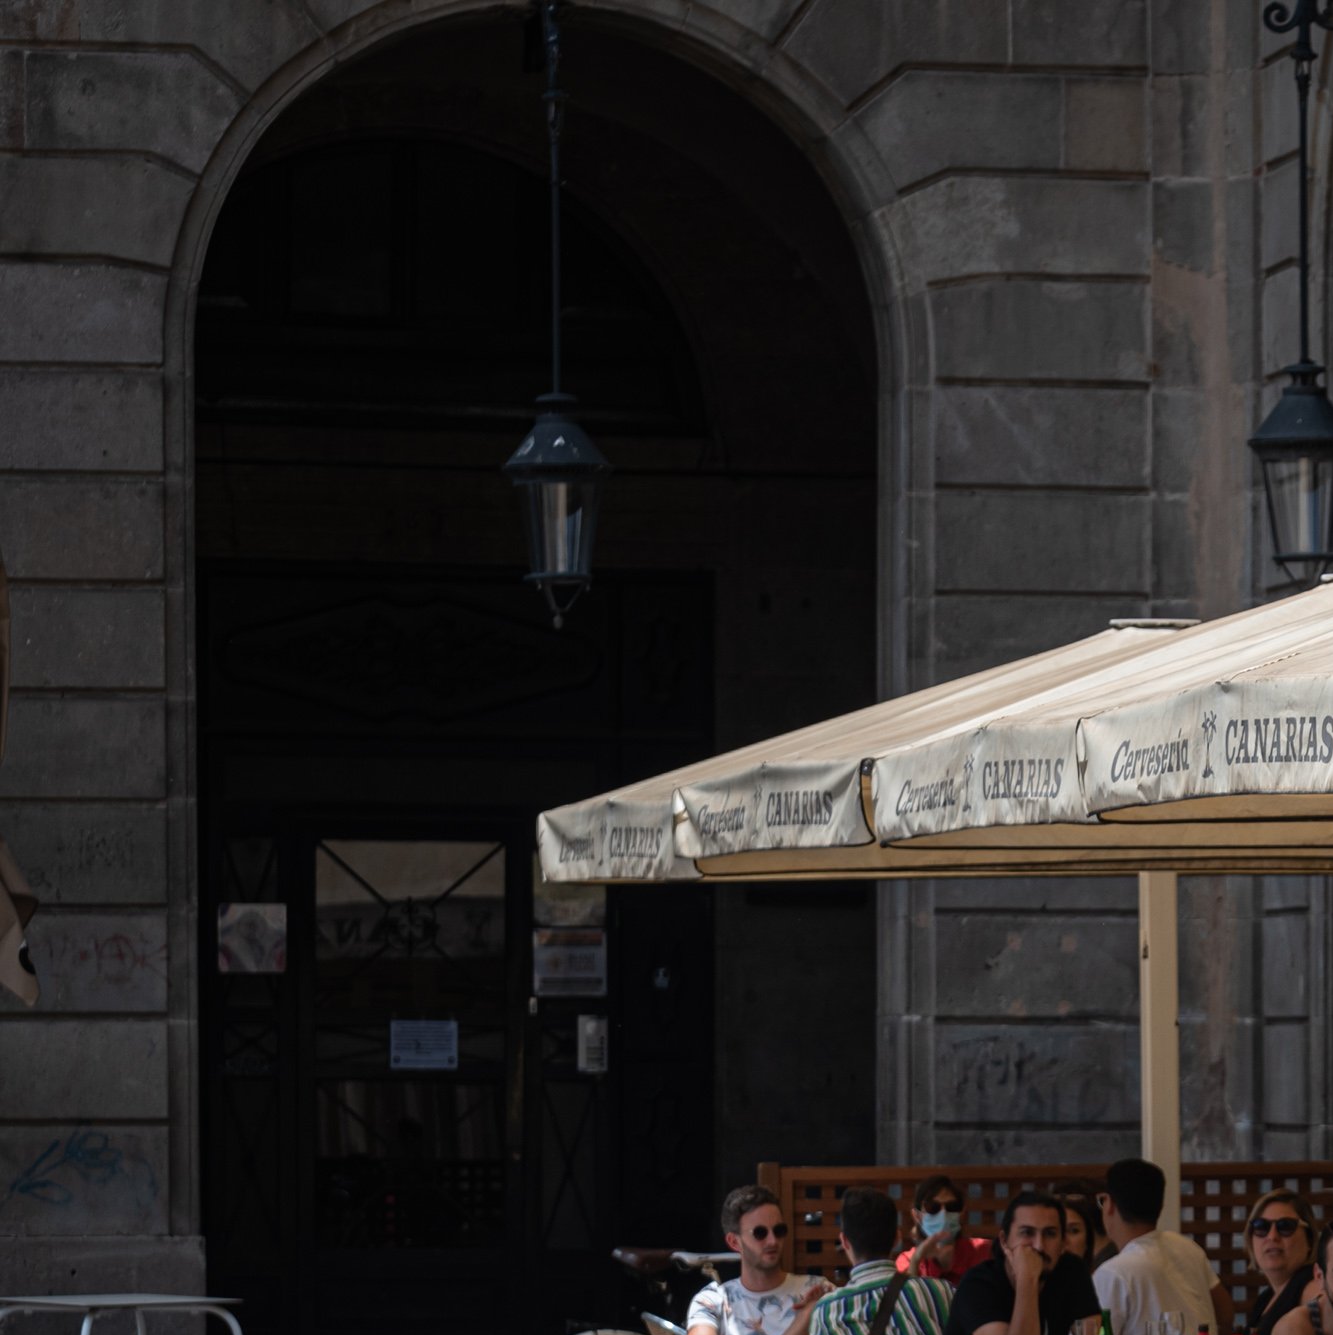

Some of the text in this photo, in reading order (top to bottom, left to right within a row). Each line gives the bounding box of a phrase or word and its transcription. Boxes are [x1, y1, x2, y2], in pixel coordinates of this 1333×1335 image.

[982, 758, 1065, 800] CANARIAS
[766, 789, 833, 828] CANARIAS
[608, 825, 663, 859] CANARIAS
